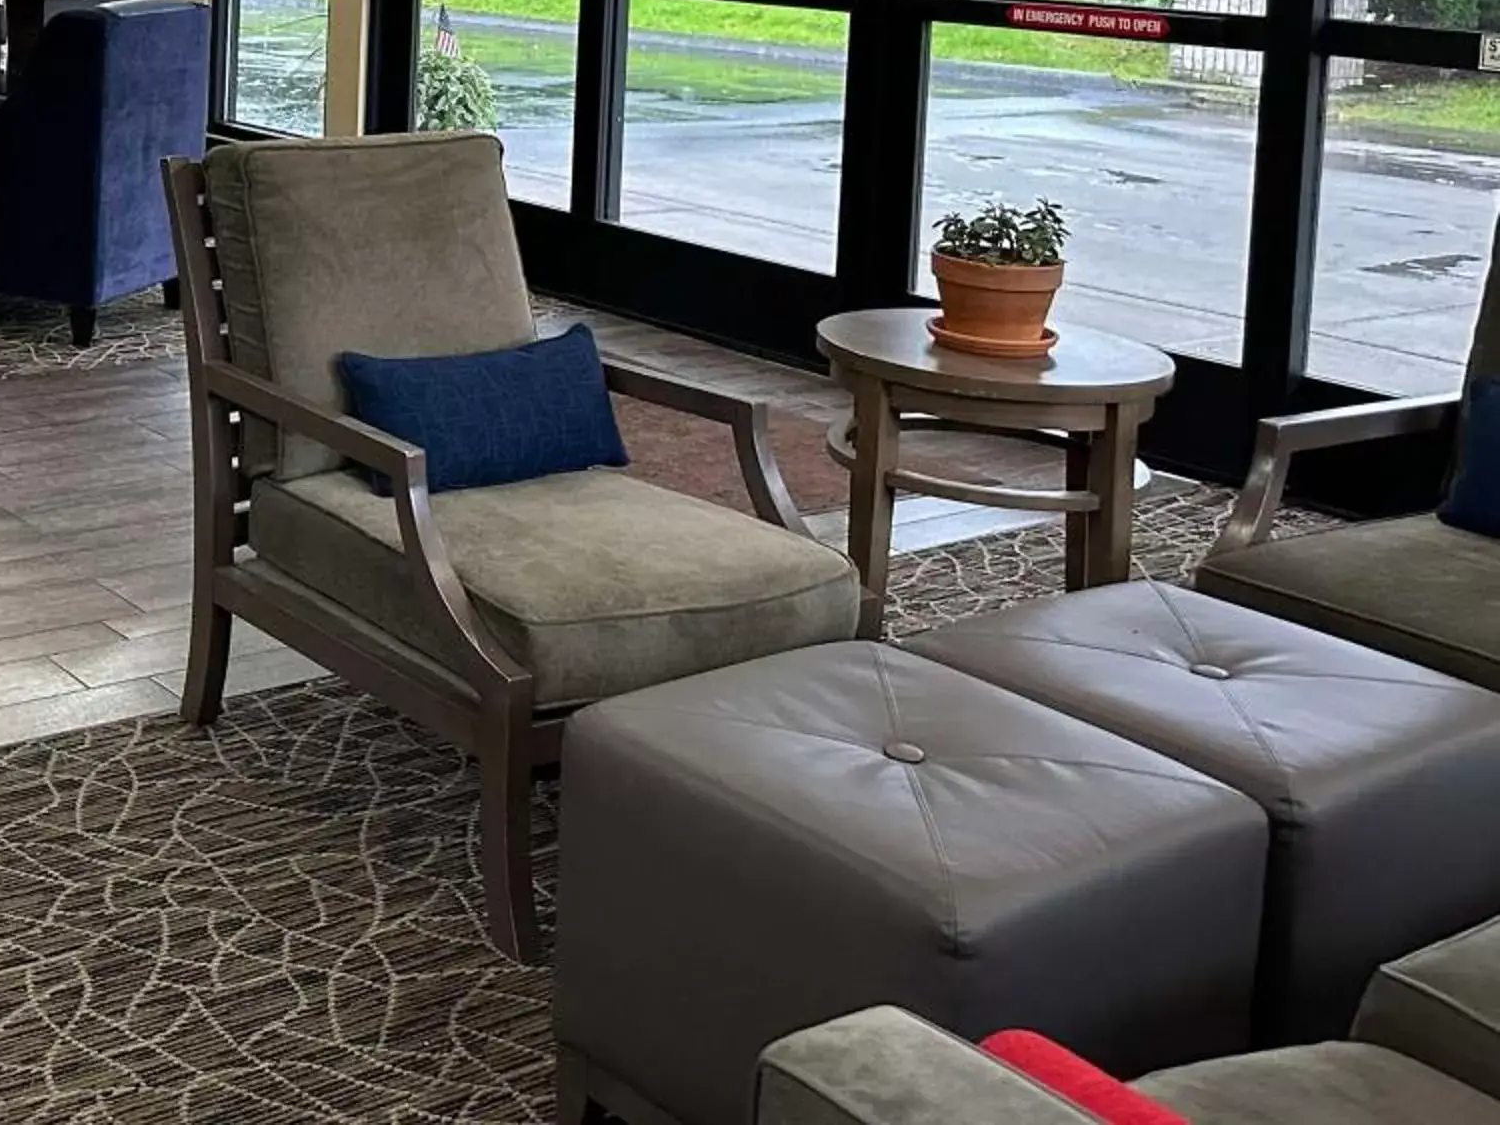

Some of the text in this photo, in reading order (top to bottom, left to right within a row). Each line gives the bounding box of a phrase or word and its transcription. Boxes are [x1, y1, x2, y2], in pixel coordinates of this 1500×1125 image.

[1013, 6, 1161, 34] IN EMERGENCY PUSH TO OPEN
